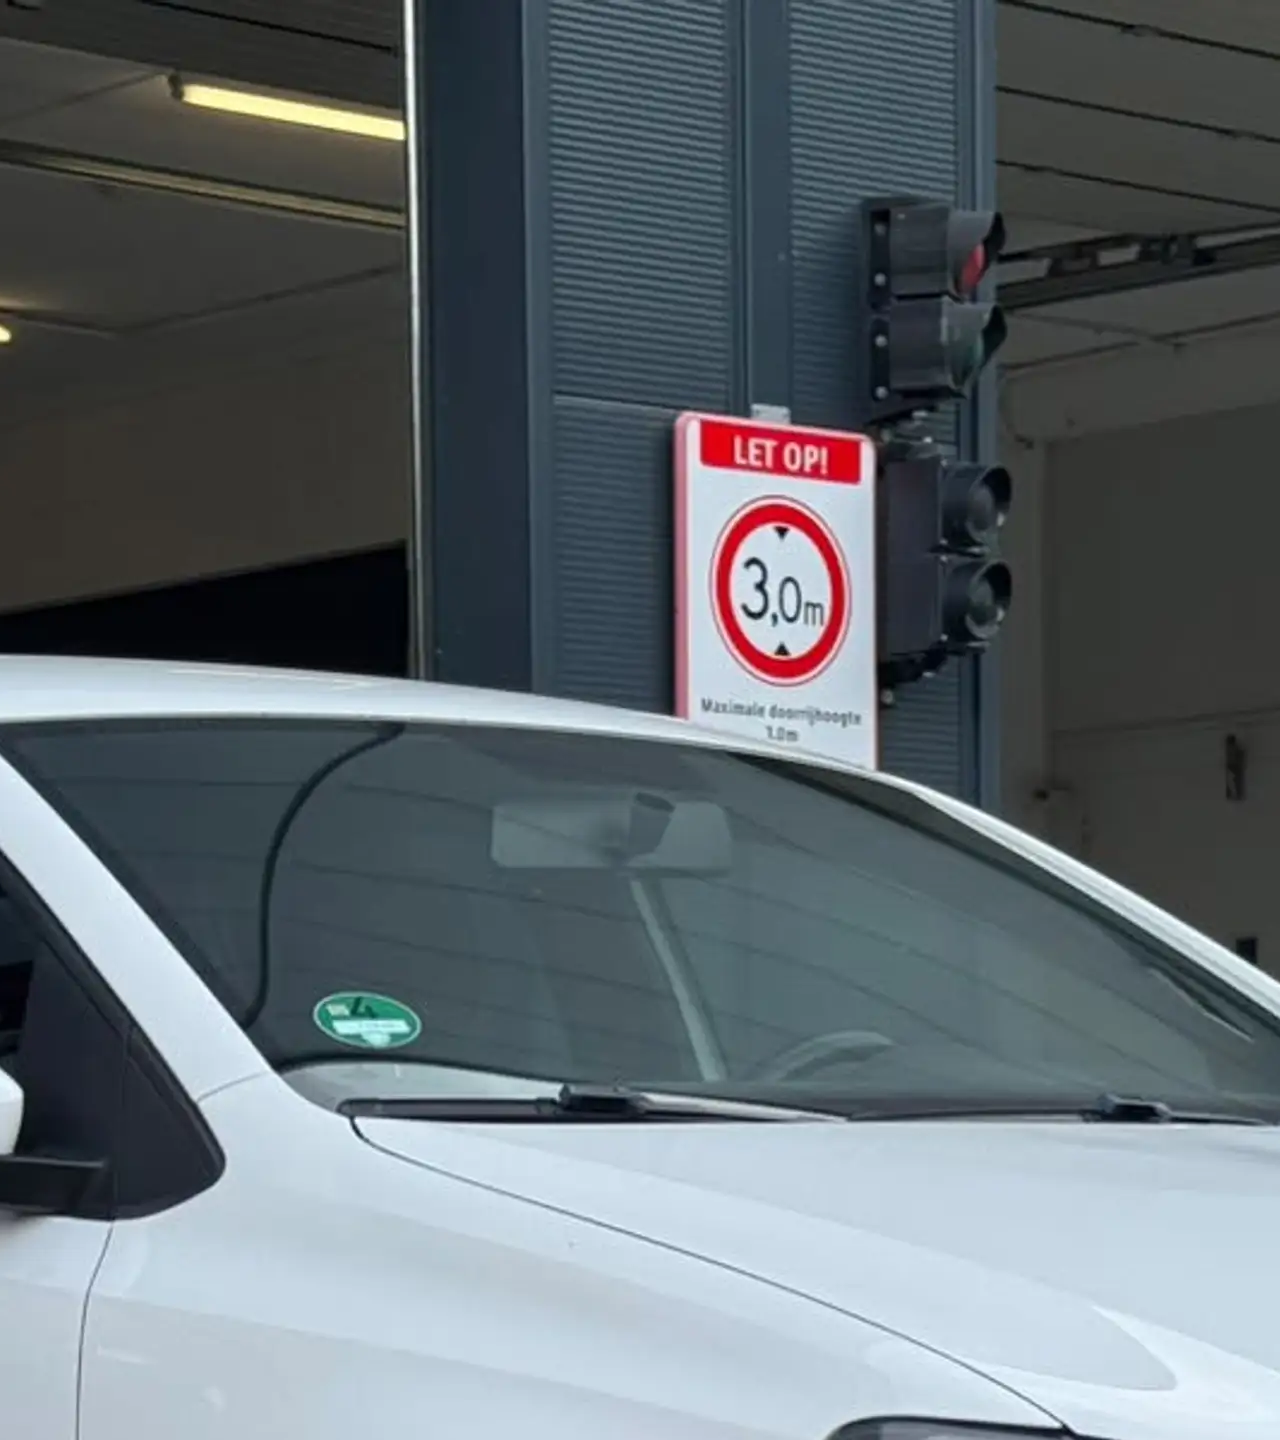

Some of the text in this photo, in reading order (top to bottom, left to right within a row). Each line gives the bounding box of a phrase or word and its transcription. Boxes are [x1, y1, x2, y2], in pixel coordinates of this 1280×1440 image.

[734, 435, 828, 475] LET OP!
[700, 698, 765, 718] Maximale
